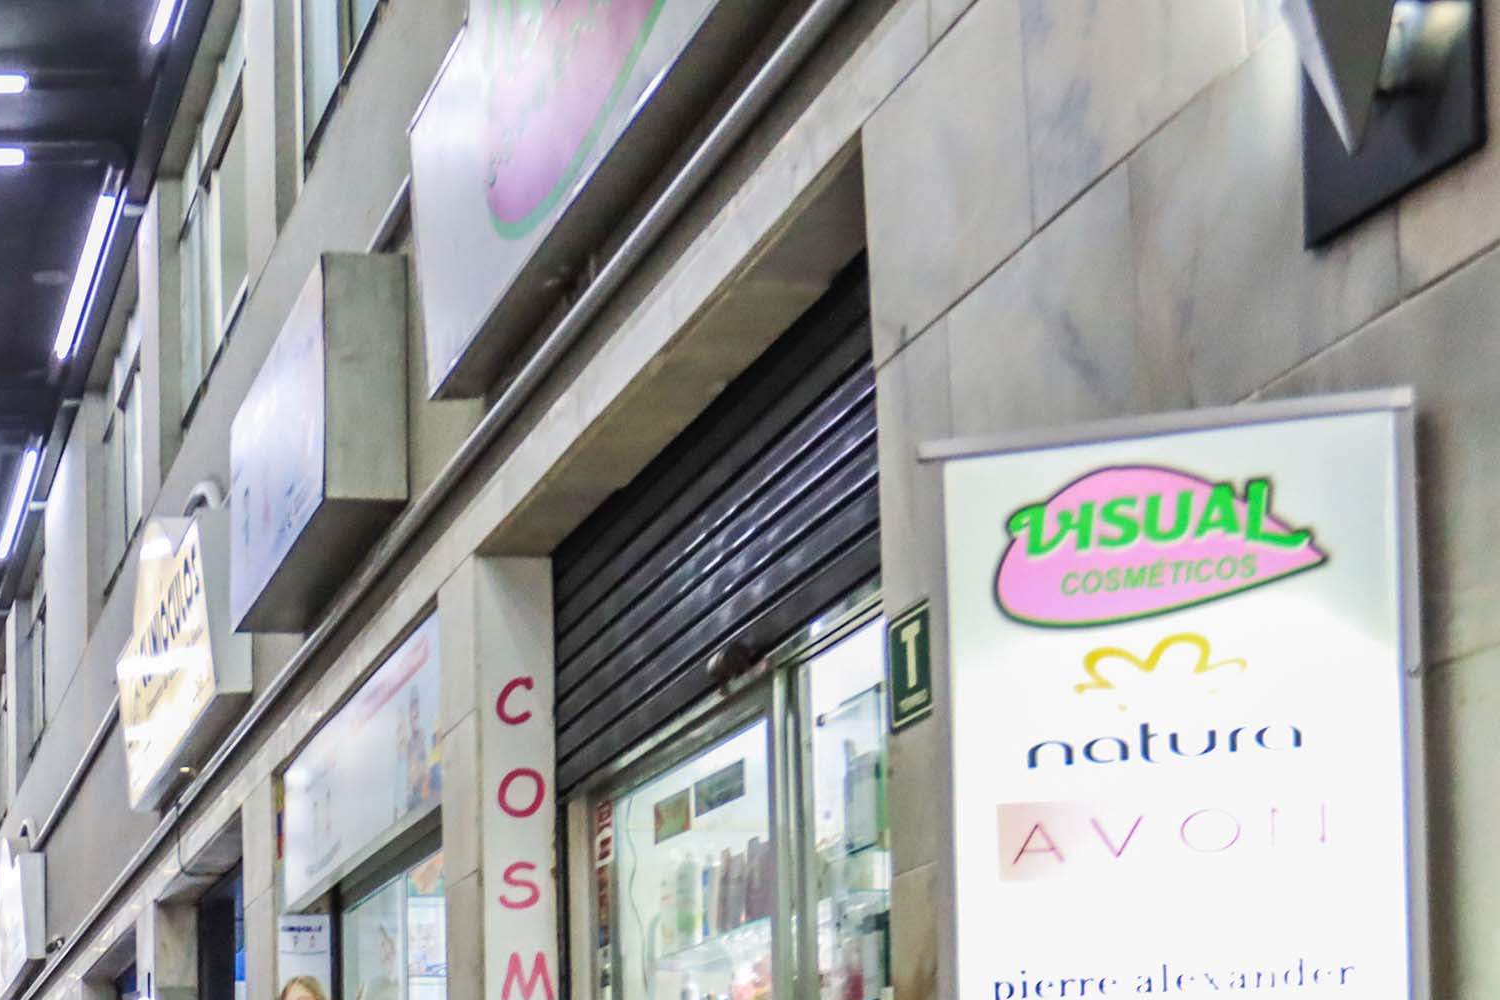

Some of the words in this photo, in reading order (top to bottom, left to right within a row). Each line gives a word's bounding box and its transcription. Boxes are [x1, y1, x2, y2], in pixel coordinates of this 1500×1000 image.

[1007, 478, 1310, 556] VISUAL
[1060, 553, 1258, 597] COSMÉTICOS
[1026, 723, 1302, 769] natura
[1135, 958, 1356, 994] alexander
